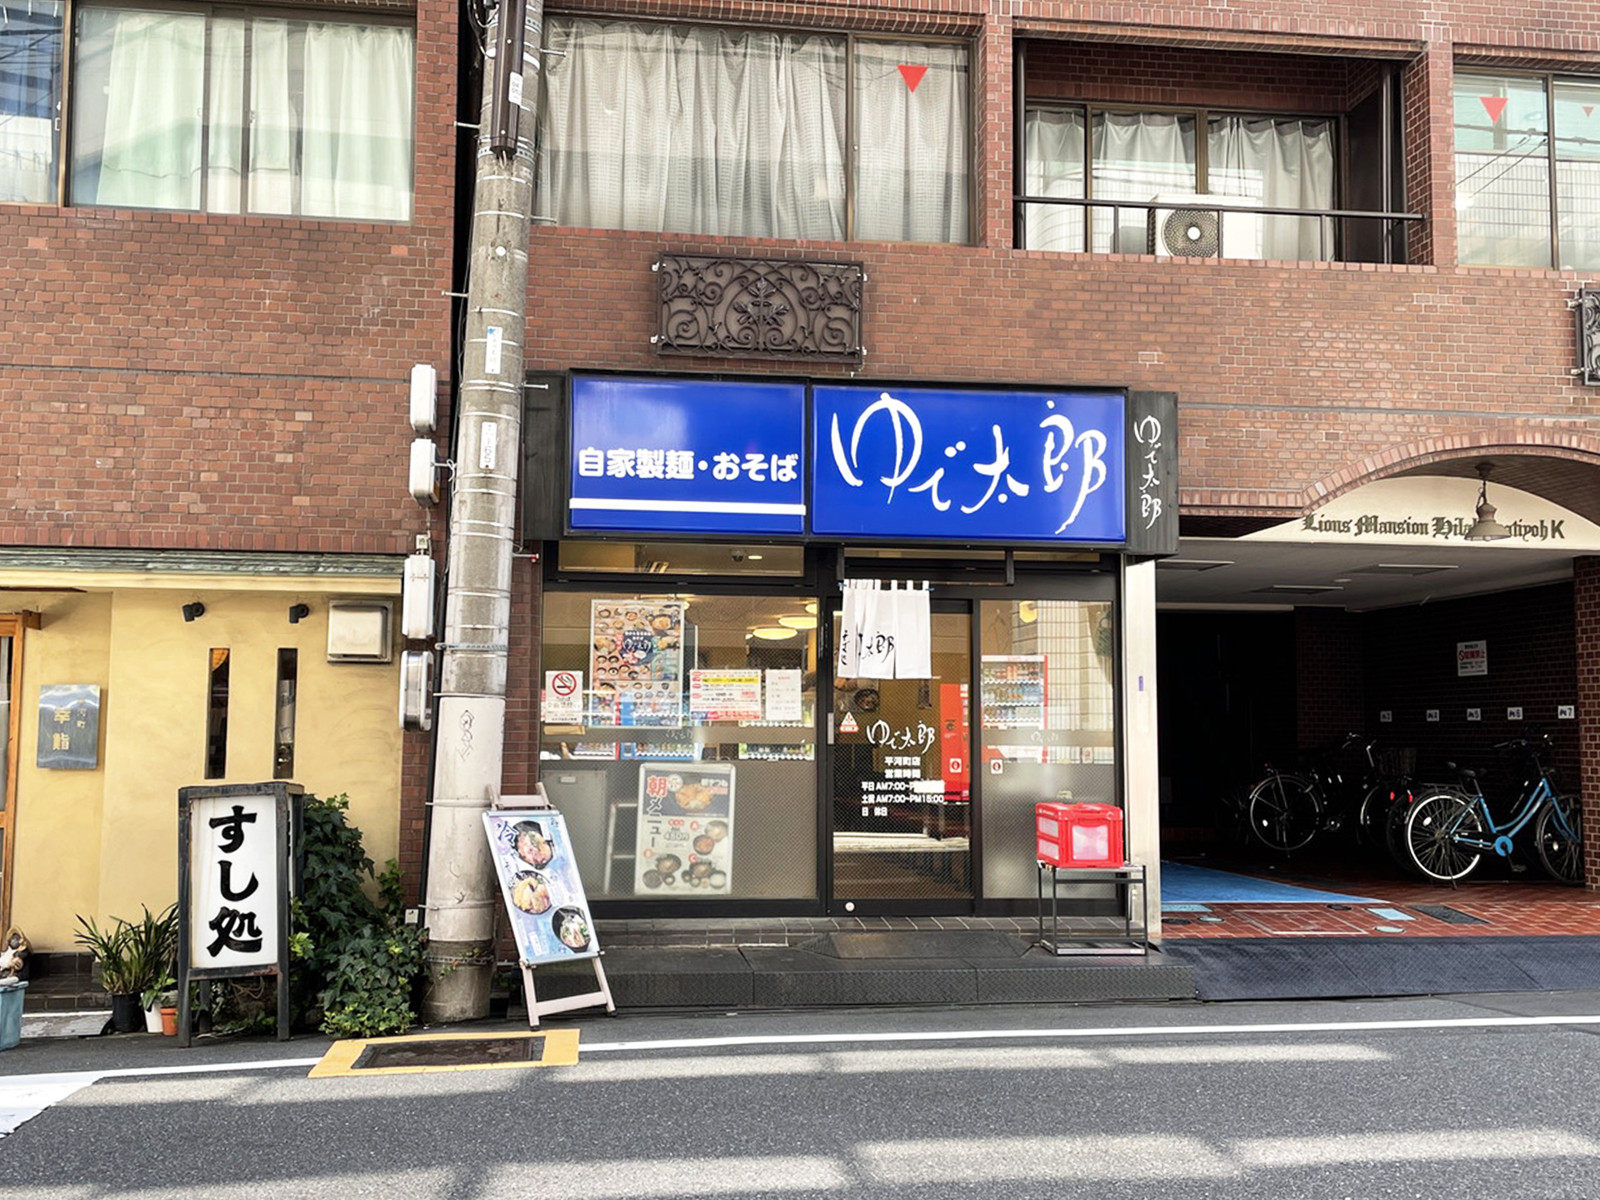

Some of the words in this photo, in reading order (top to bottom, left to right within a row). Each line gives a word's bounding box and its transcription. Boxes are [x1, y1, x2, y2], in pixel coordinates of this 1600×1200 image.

[578, 447, 799, 482] 自家製麺・おそば
[831, 392, 1107, 535] ゆで太郎
[1133, 415, 1162, 530] ゆで太郎
[1301, 513, 1351, 533] Lions
[1354, 514, 1430, 536] Mansion
[1551, 519, 1566, 539] K
[866, 720, 936, 755] ゆで太郎
[206, 805, 263, 957] すし処
